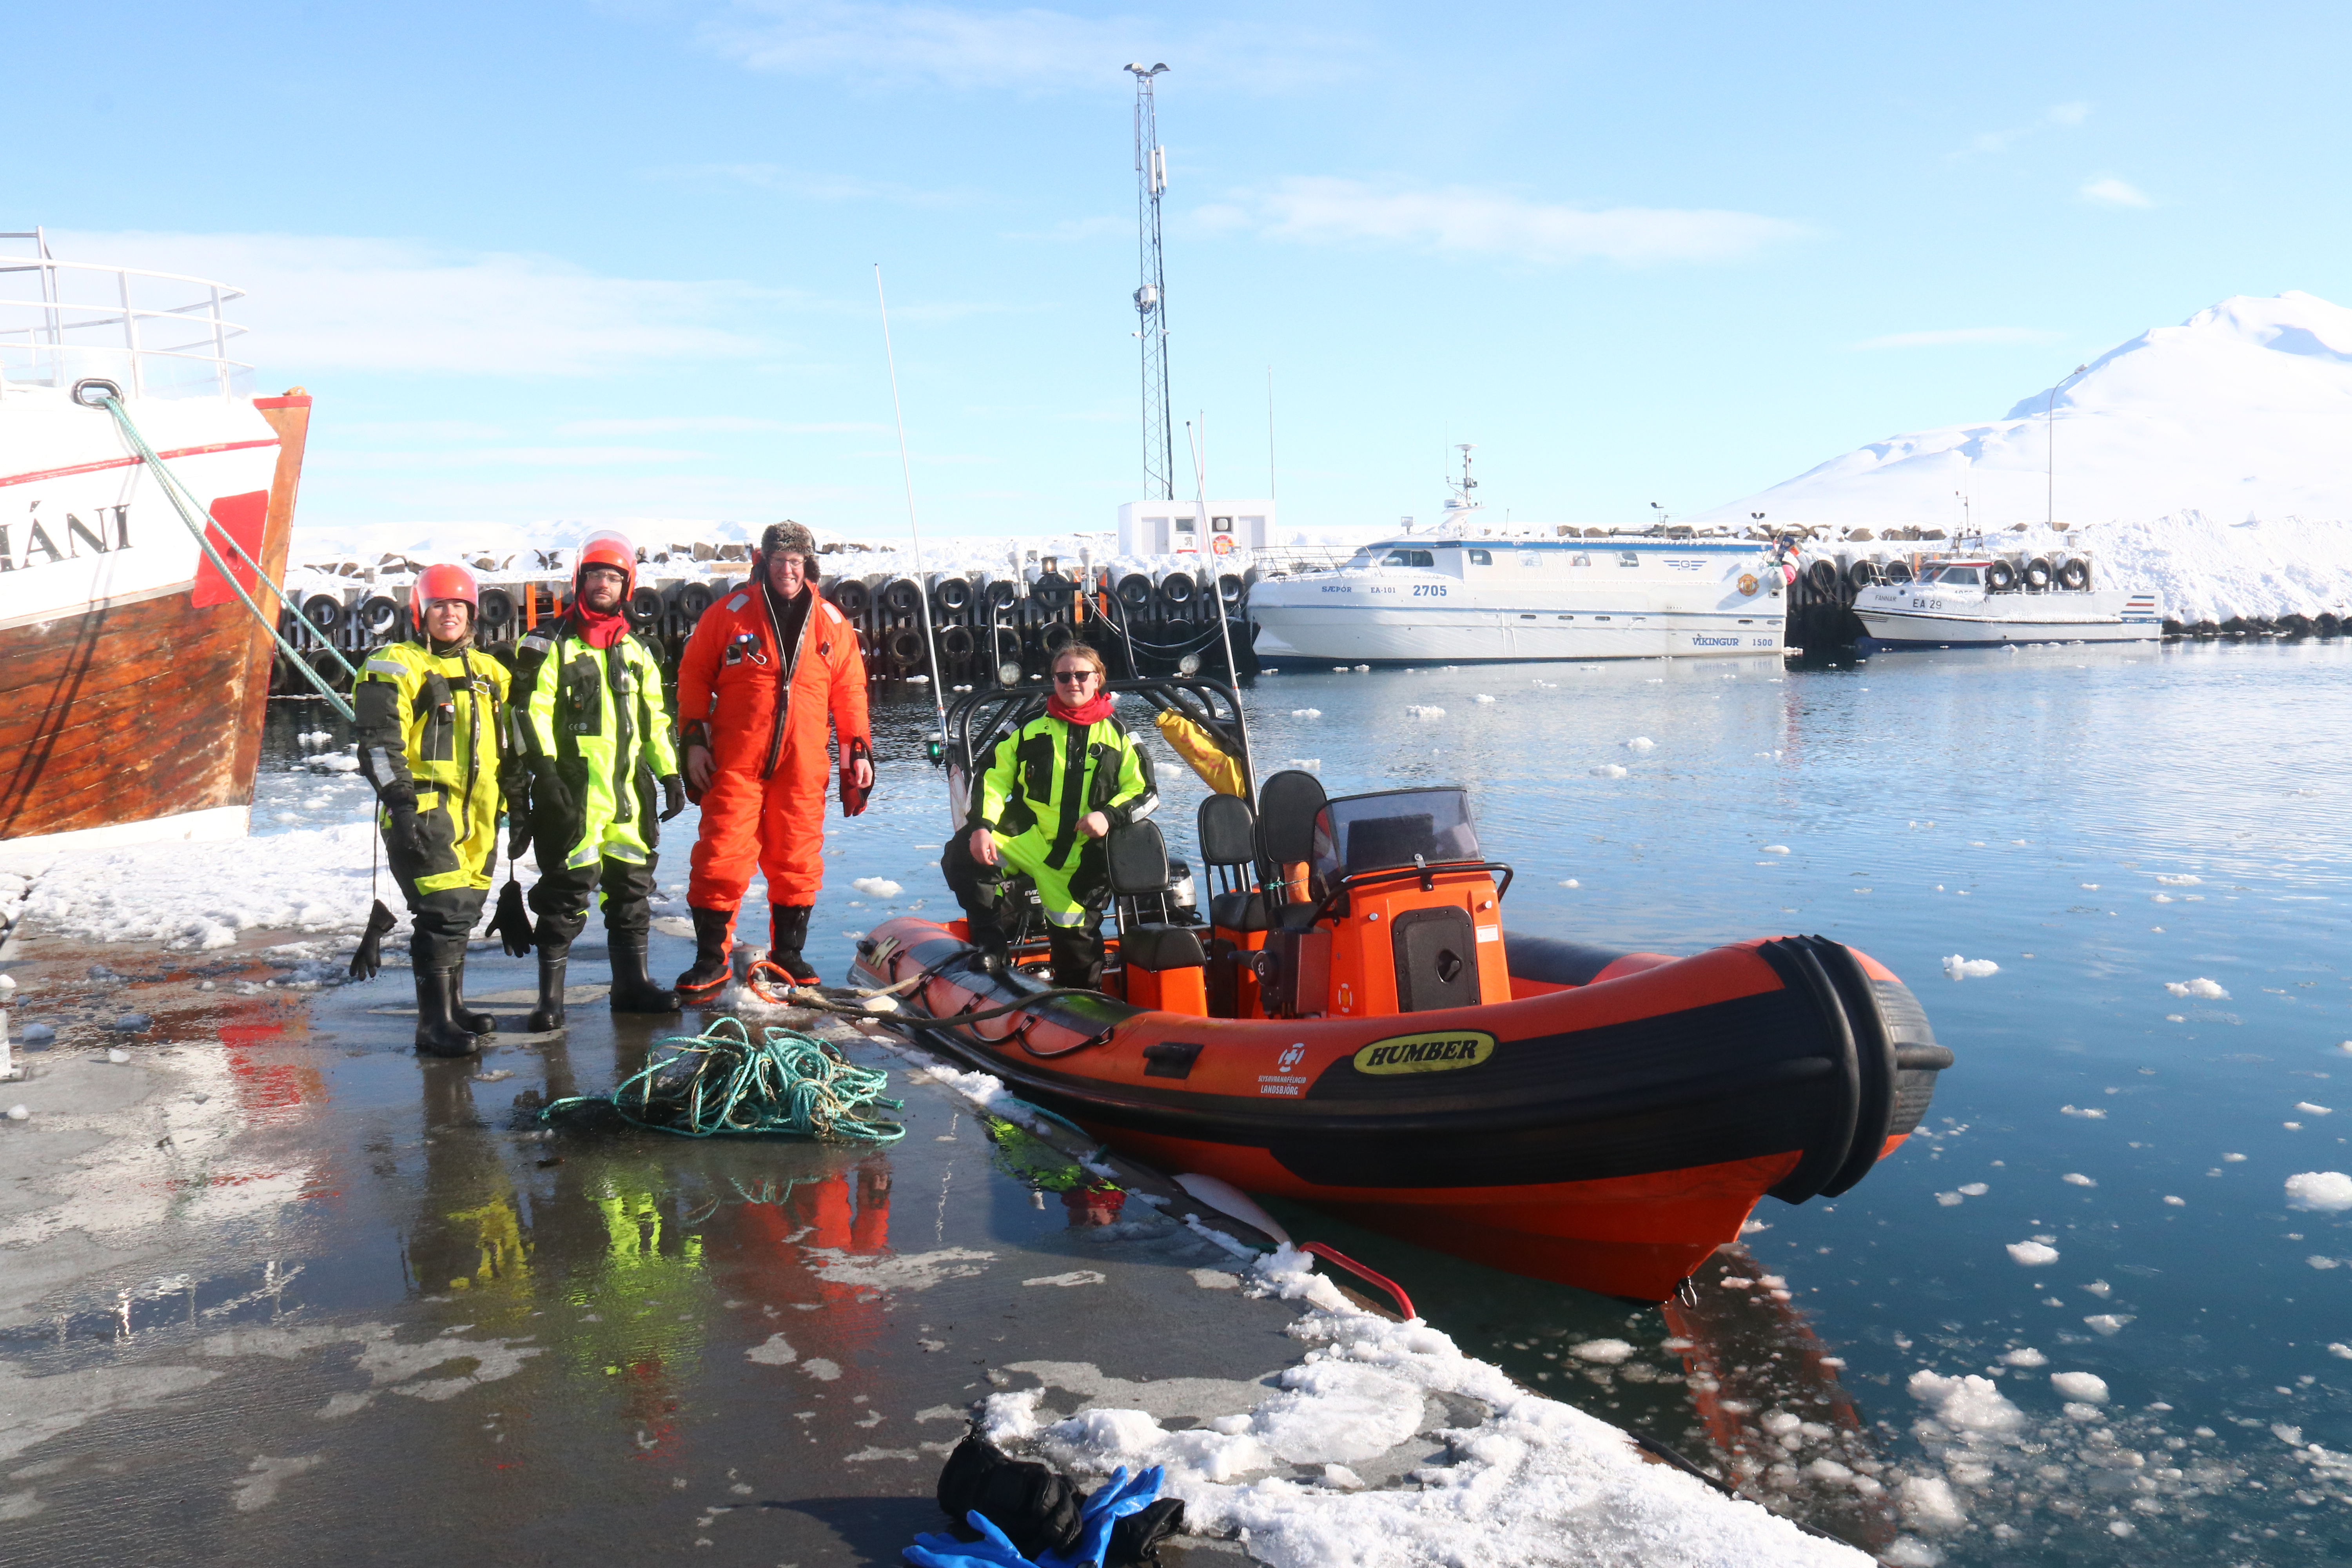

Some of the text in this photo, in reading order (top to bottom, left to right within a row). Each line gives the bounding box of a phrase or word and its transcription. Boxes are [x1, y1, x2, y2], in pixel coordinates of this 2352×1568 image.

[1413, 585, 1447, 596] 2705
[1913, 599, 1942, 609] EA 29
[1367, 1040, 1478, 1066] HUMBER
[1260, 1084, 1299, 1095] LANDSBJÖRG
